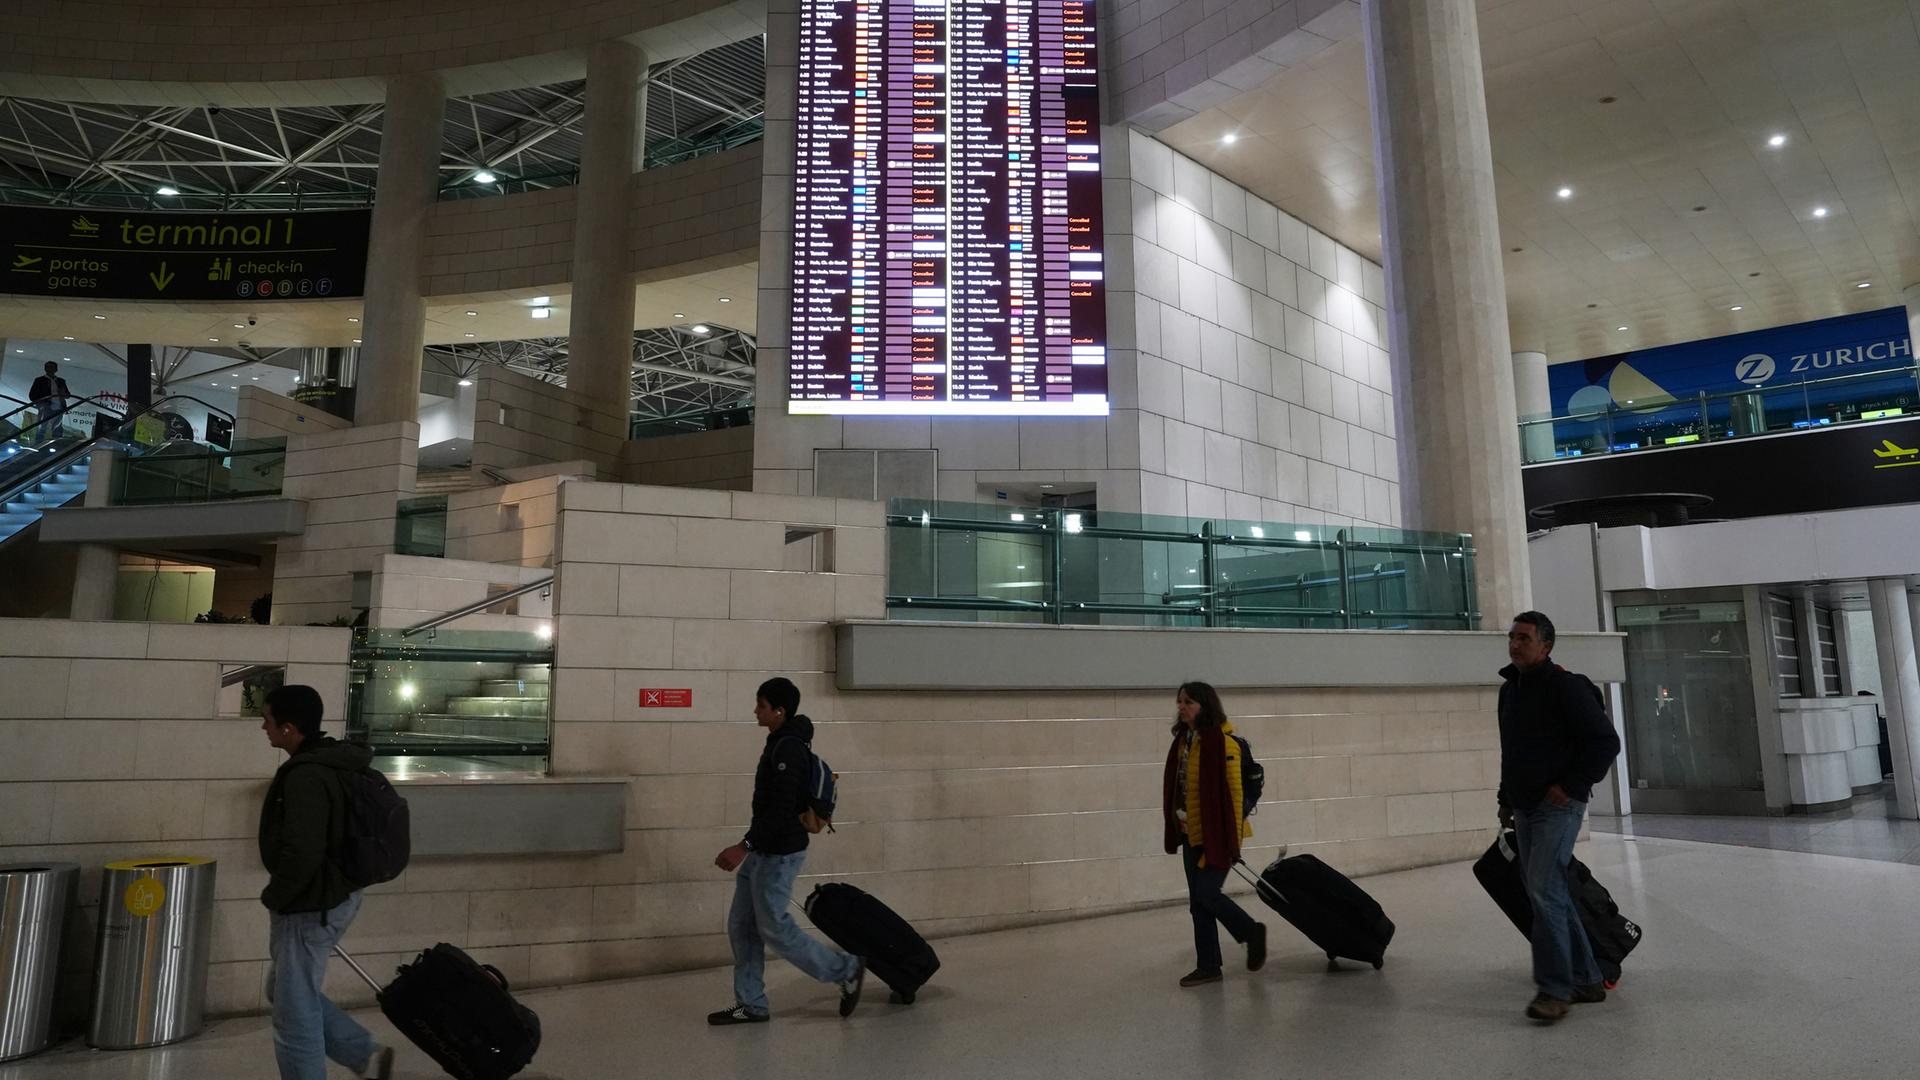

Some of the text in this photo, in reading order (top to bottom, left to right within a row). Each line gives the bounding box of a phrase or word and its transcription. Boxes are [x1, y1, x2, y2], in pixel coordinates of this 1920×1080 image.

[120, 218, 294, 246] terminal 1
[50, 258, 109, 274] portas
[238, 260, 303, 274] check-in
[48, 274, 97, 290] gates
[1790, 338, 1910, 372] ZURICH
